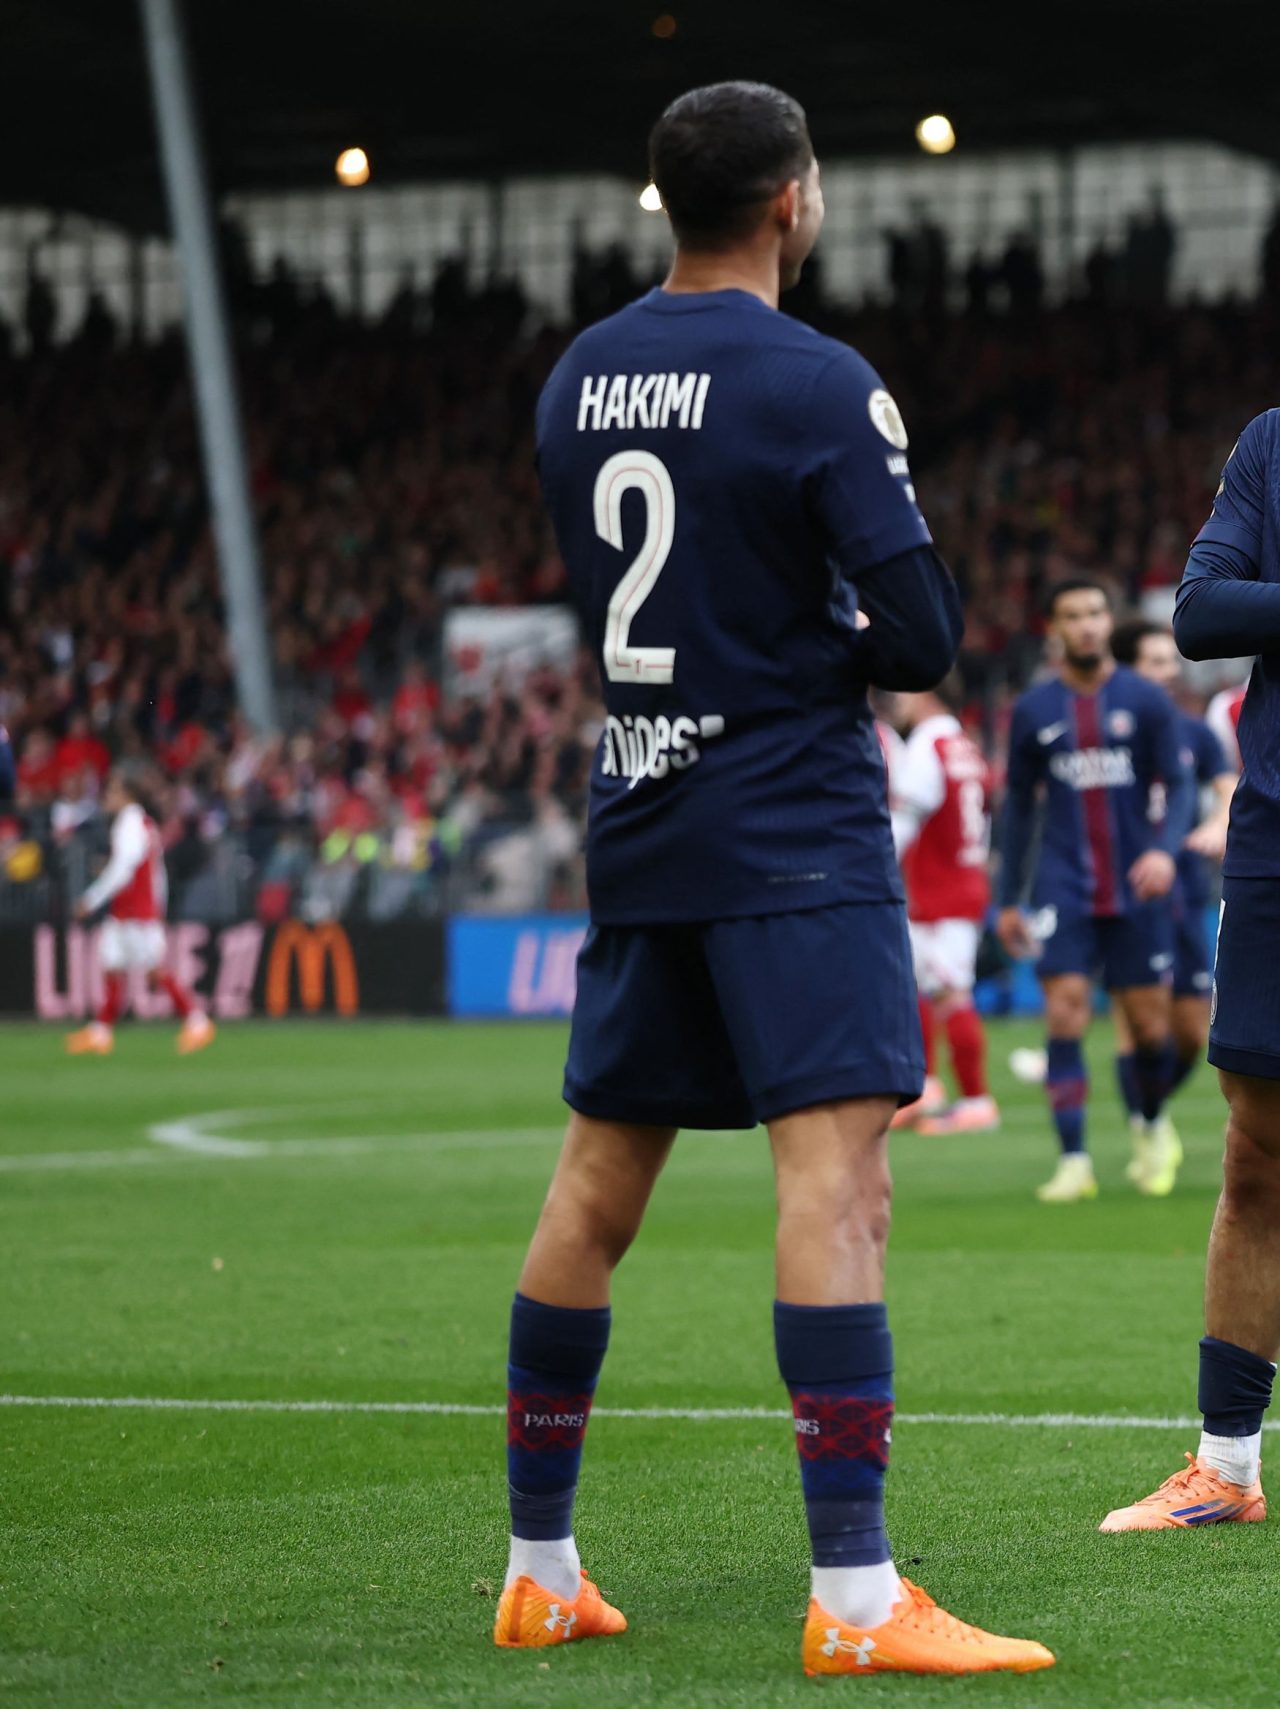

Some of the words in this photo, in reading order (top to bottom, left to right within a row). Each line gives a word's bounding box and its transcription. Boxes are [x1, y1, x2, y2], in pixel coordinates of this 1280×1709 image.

[577, 372, 711, 431] HAKIMI
[593, 450, 676, 684] 2
[524, 1412, 585, 1428] PARIS
